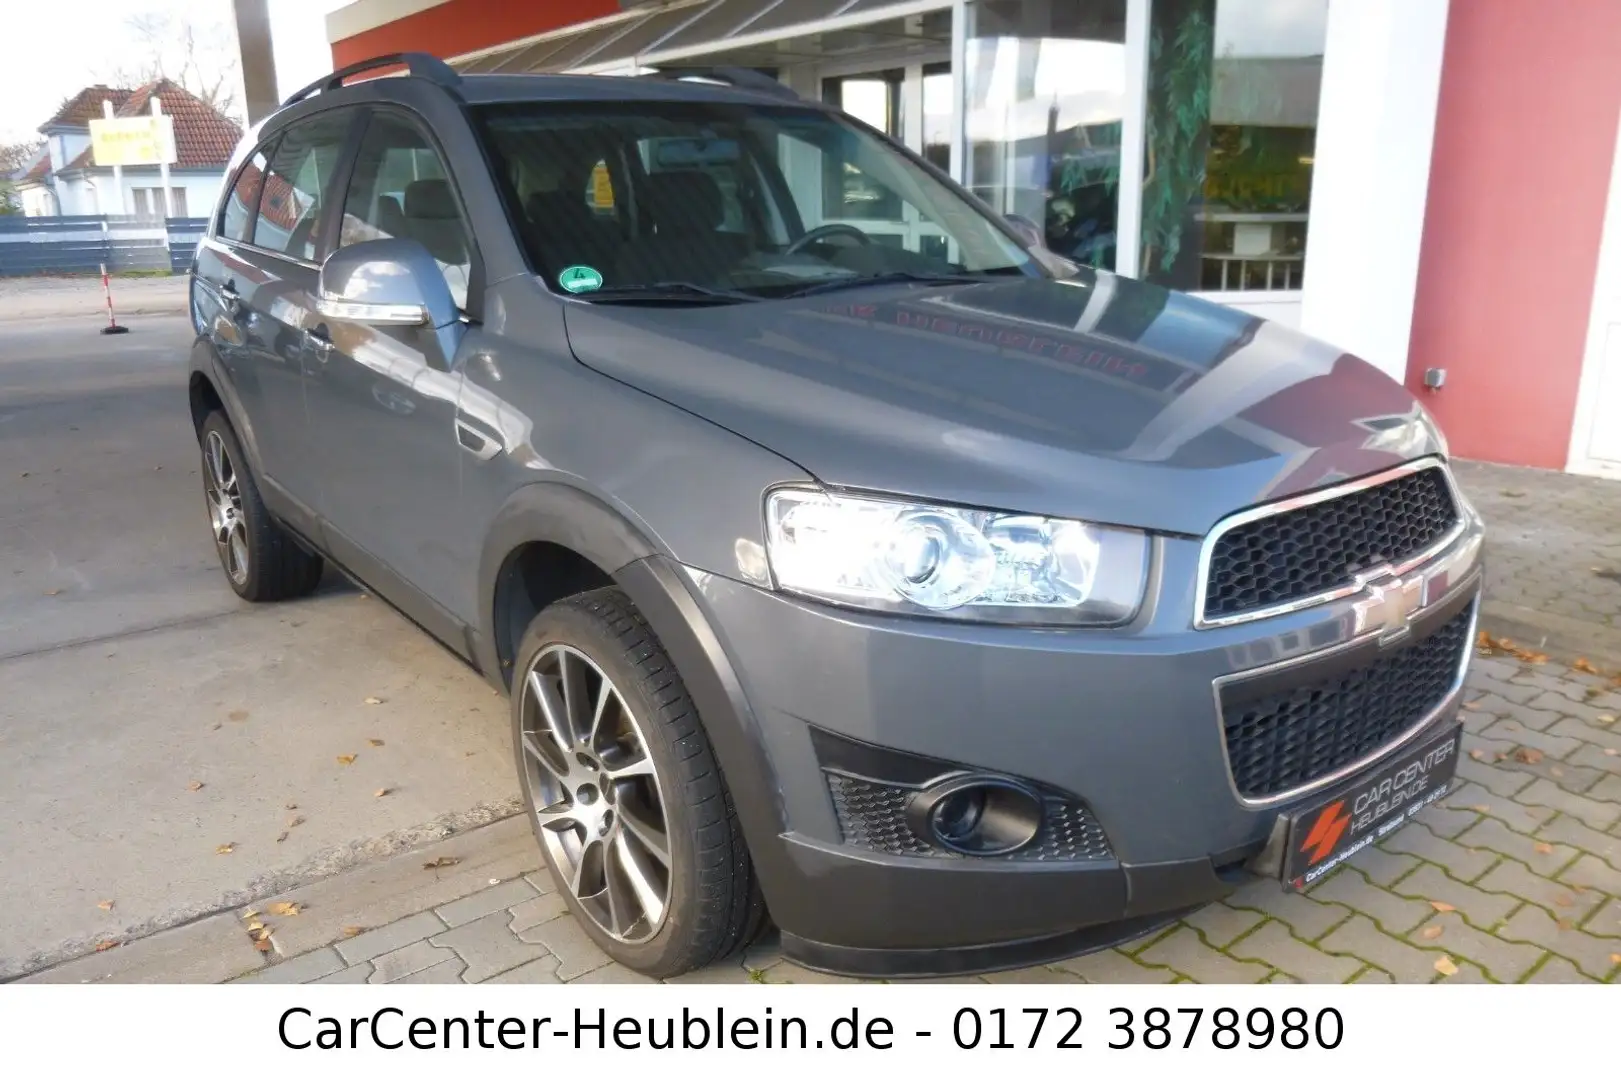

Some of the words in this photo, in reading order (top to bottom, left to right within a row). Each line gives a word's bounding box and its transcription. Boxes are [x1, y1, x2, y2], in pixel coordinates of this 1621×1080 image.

[573, 268, 585, 279] 4
[1350, 775, 1429, 835] HEUBLEIN.DE
[1354, 778, 1392, 815] CAR
[1394, 738, 1455, 791] CENTER
